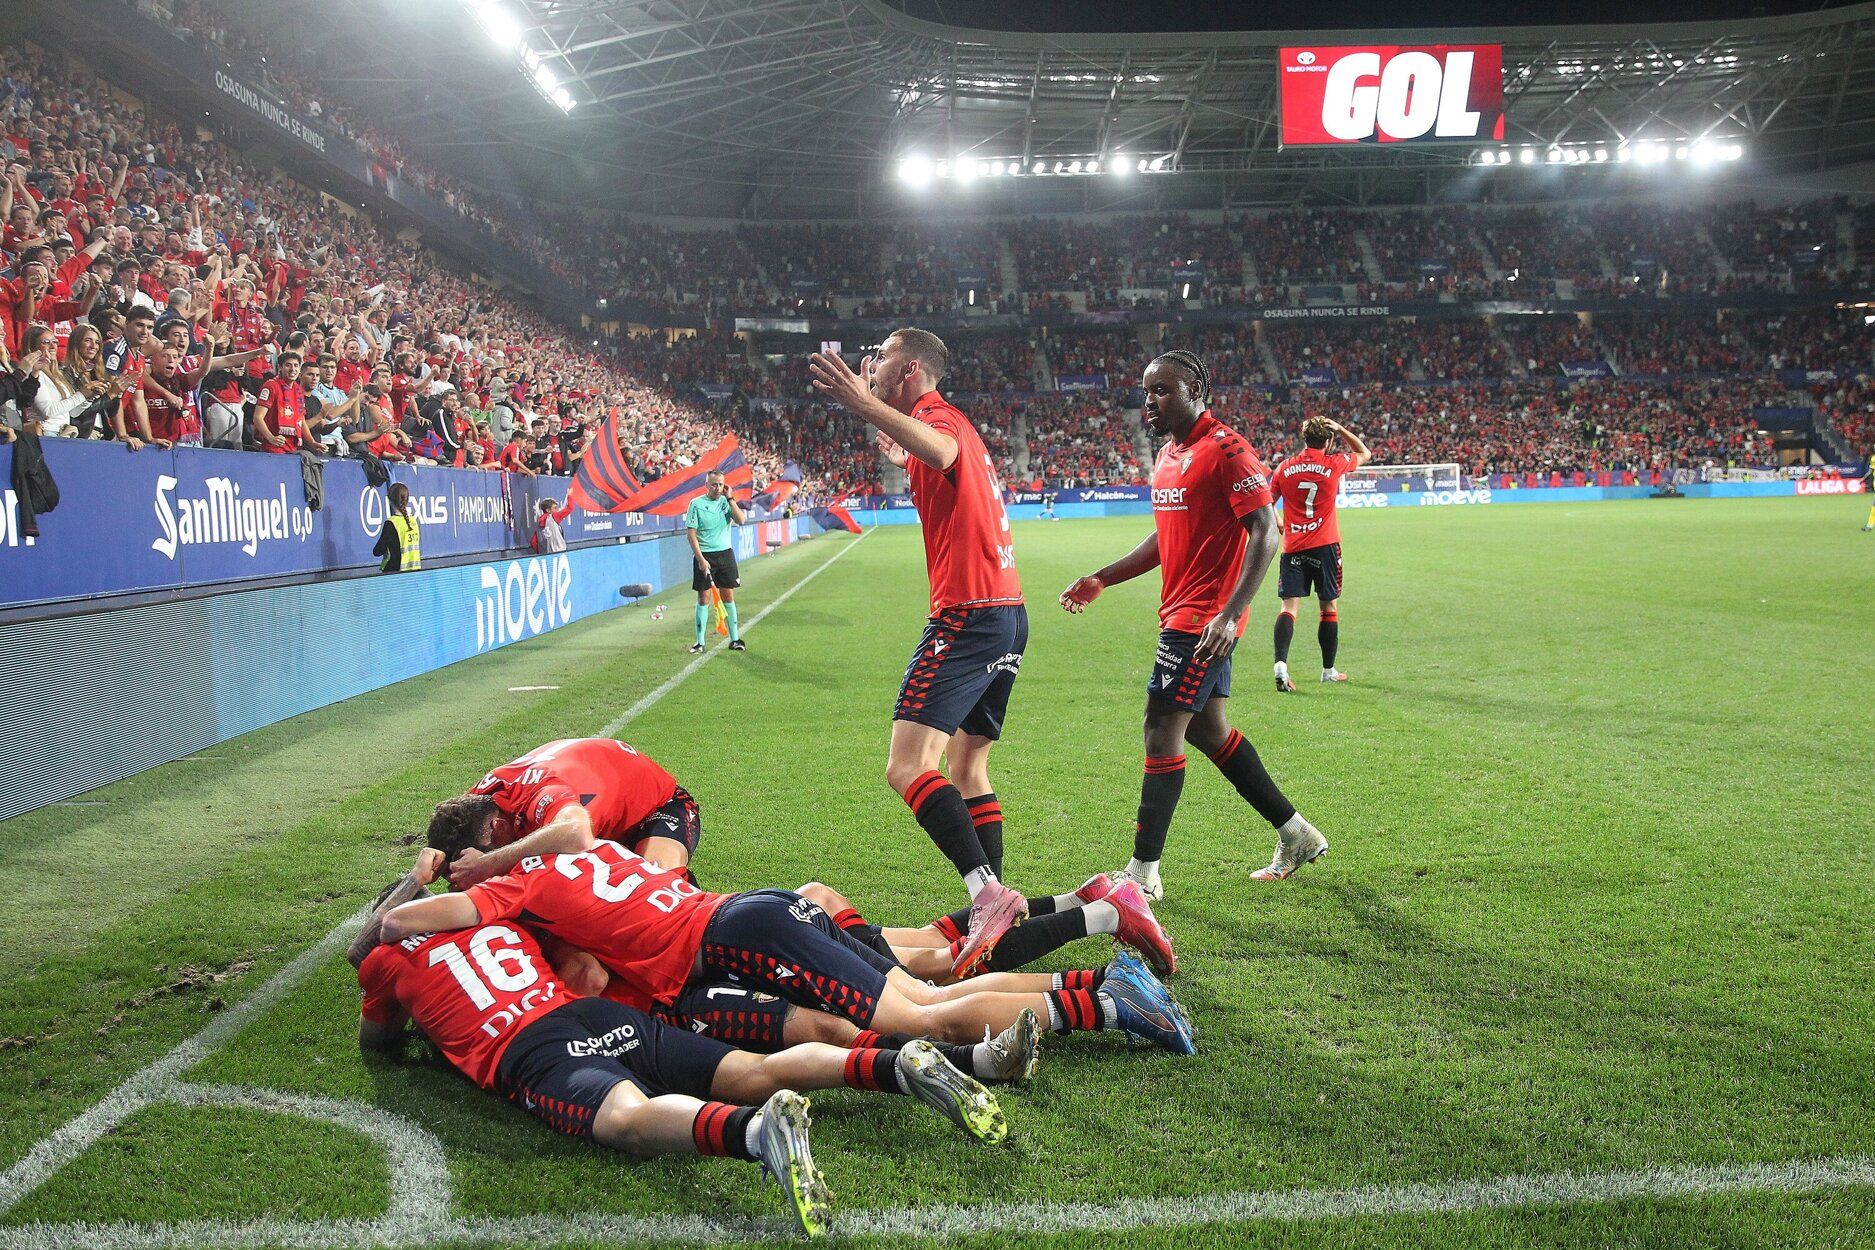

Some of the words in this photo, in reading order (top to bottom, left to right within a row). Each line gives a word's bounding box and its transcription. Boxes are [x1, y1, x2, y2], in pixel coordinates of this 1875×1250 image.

[215, 70, 260, 112] OSASUNA
[260, 98, 291, 131] NUNCA
[291, 118, 301, 138] SE
[302, 125, 325, 152] RINDE
[1321, 51, 1481, 140] GOL
[1264, 308, 1309, 318] OSASUNA
[1311, 307, 1345, 317] NUNCA
[1347, 307, 1358, 316] SE
[1360, 306, 1389, 316] RINDE
[152, 474, 289, 561] SanMiguel
[1298, 481, 1319, 519] 7
[1335, 492, 1388, 509] oeve
[1420, 489, 1492, 506] moeve
[1797, 481, 1844, 494] LALIGA
[475, 553, 572, 653] moeve
[428, 925, 539, 1012] 16
